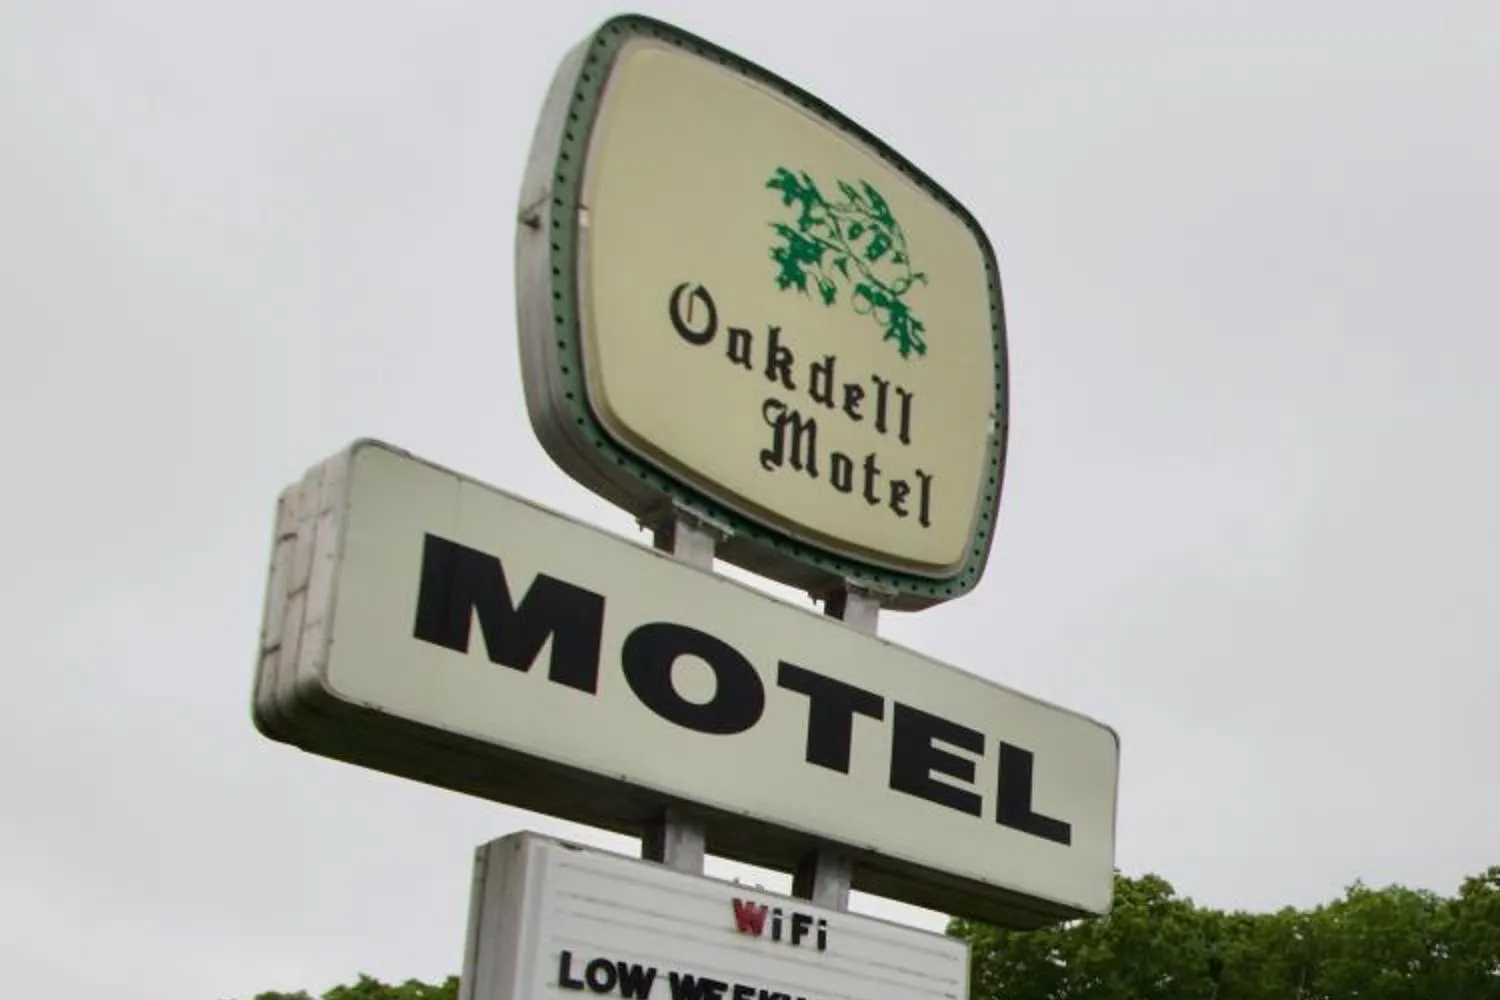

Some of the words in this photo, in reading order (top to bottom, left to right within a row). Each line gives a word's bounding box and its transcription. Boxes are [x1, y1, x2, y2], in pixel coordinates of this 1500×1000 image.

[669, 281, 912, 445] Oakdell
[760, 398, 932, 527] Motel
[413, 533, 1071, 845] MOTEL
[733, 899, 827, 951] WiFi
